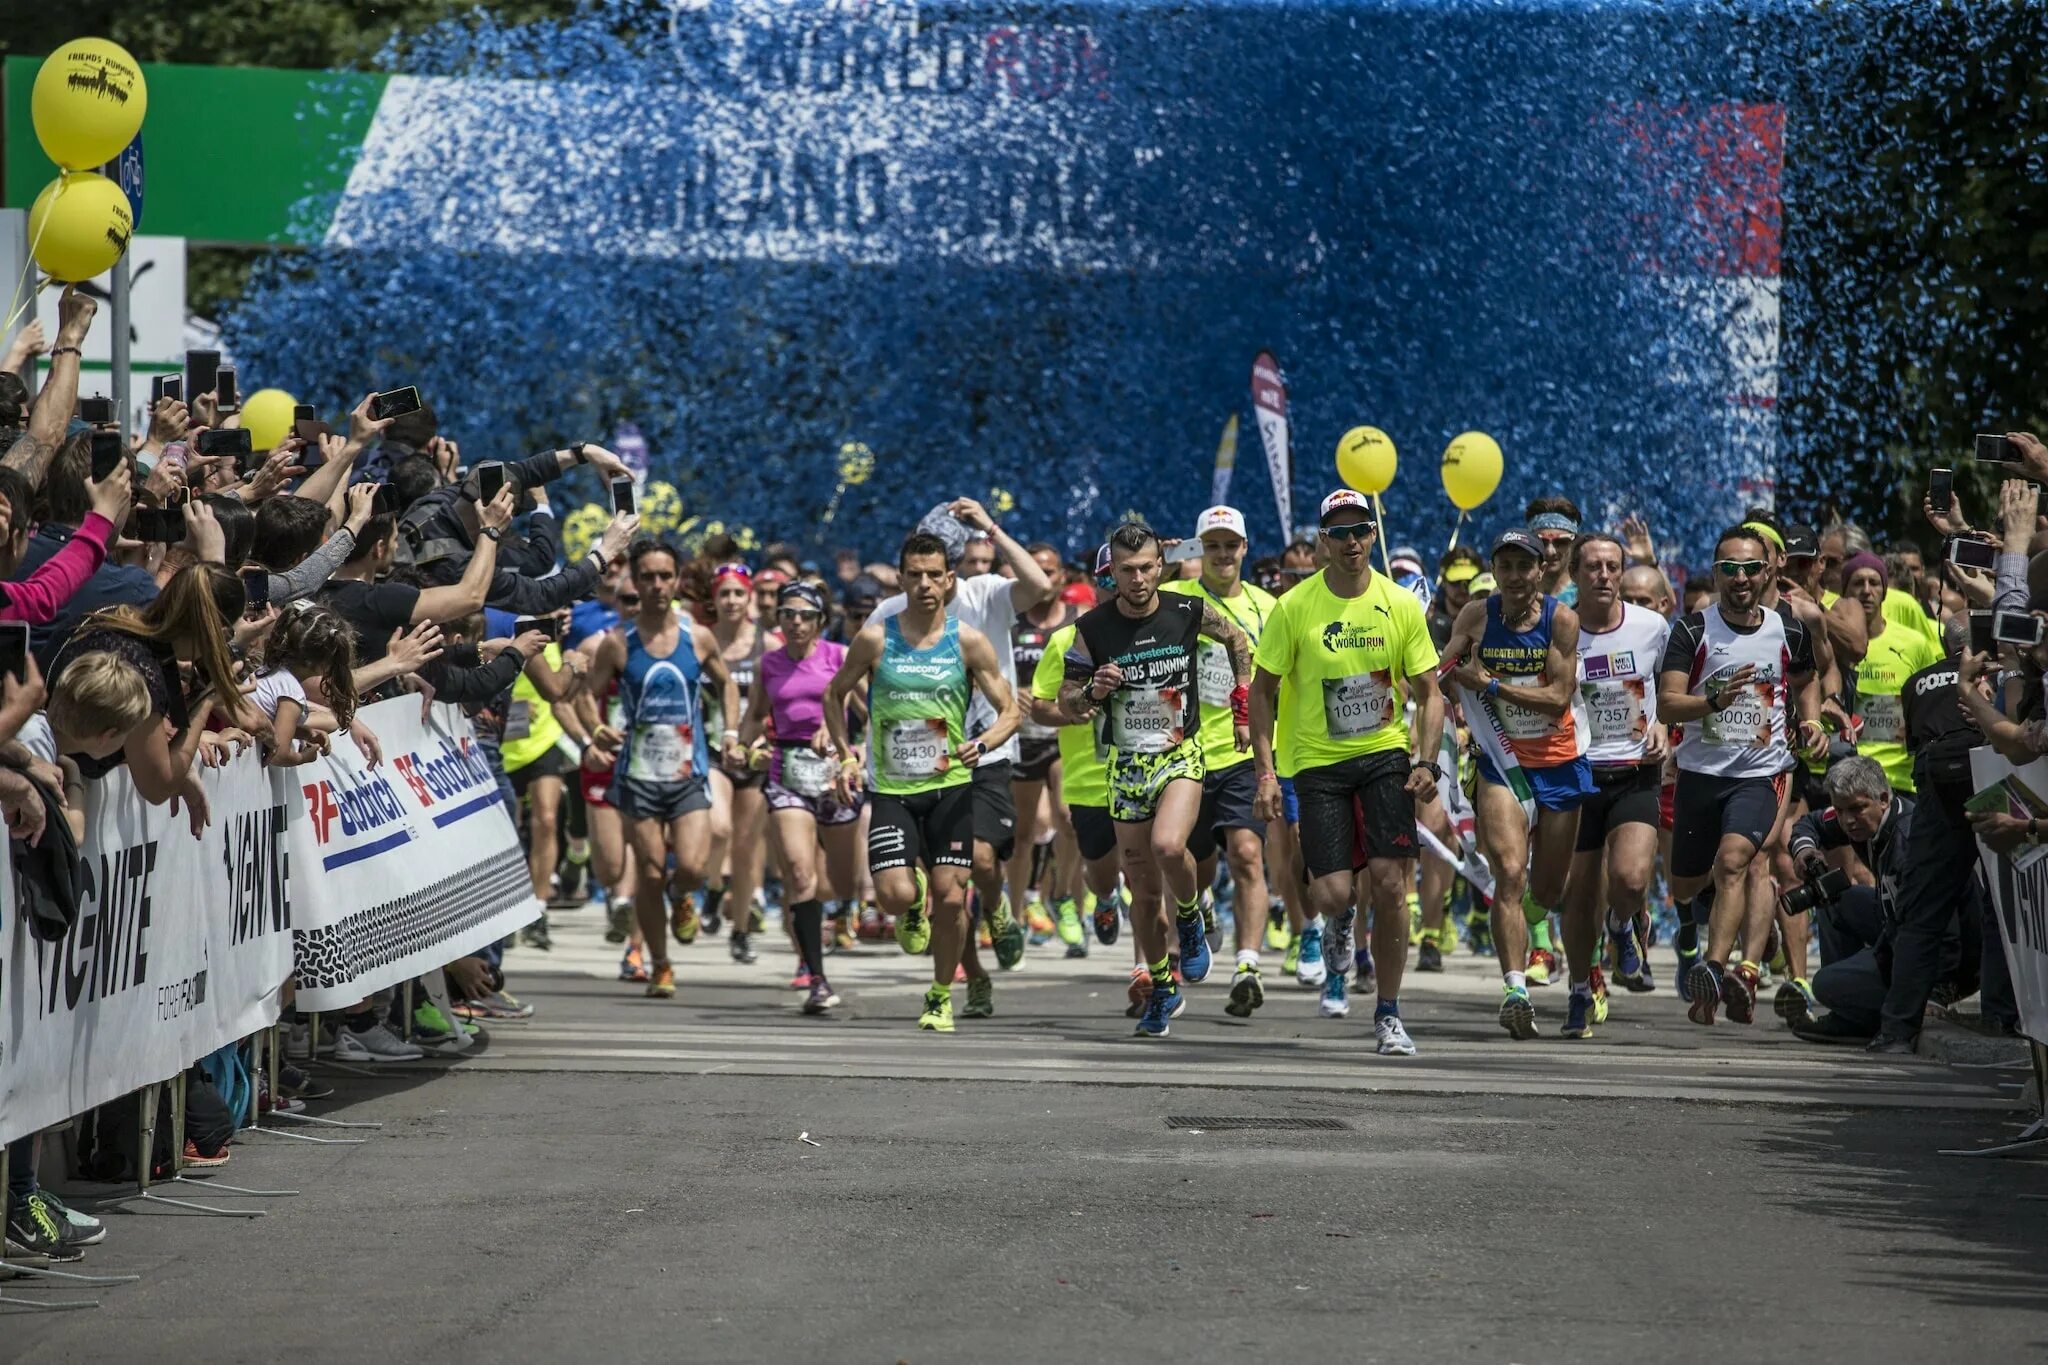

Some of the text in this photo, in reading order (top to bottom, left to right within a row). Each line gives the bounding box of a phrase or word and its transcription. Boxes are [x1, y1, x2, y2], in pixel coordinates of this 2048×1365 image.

[68, 53, 102, 63] FRIENDS
[1133, 644, 1186, 663] yesterday.
[1483, 648, 1548, 659] CALCATERRA SPO
[896, 665, 941, 675] saucony
[1495, 662, 1544, 672] POLAR
[1334, 695, 1386, 718] 103107
[1594, 707, 1630, 723] 7357
[1715, 710, 1761, 725] 30030
[1125, 717, 1170, 730] 88882
[1602, 723, 1626, 731] Renzo
[1726, 725, 1748, 734] Denis
[892, 745, 937, 760] 28430
